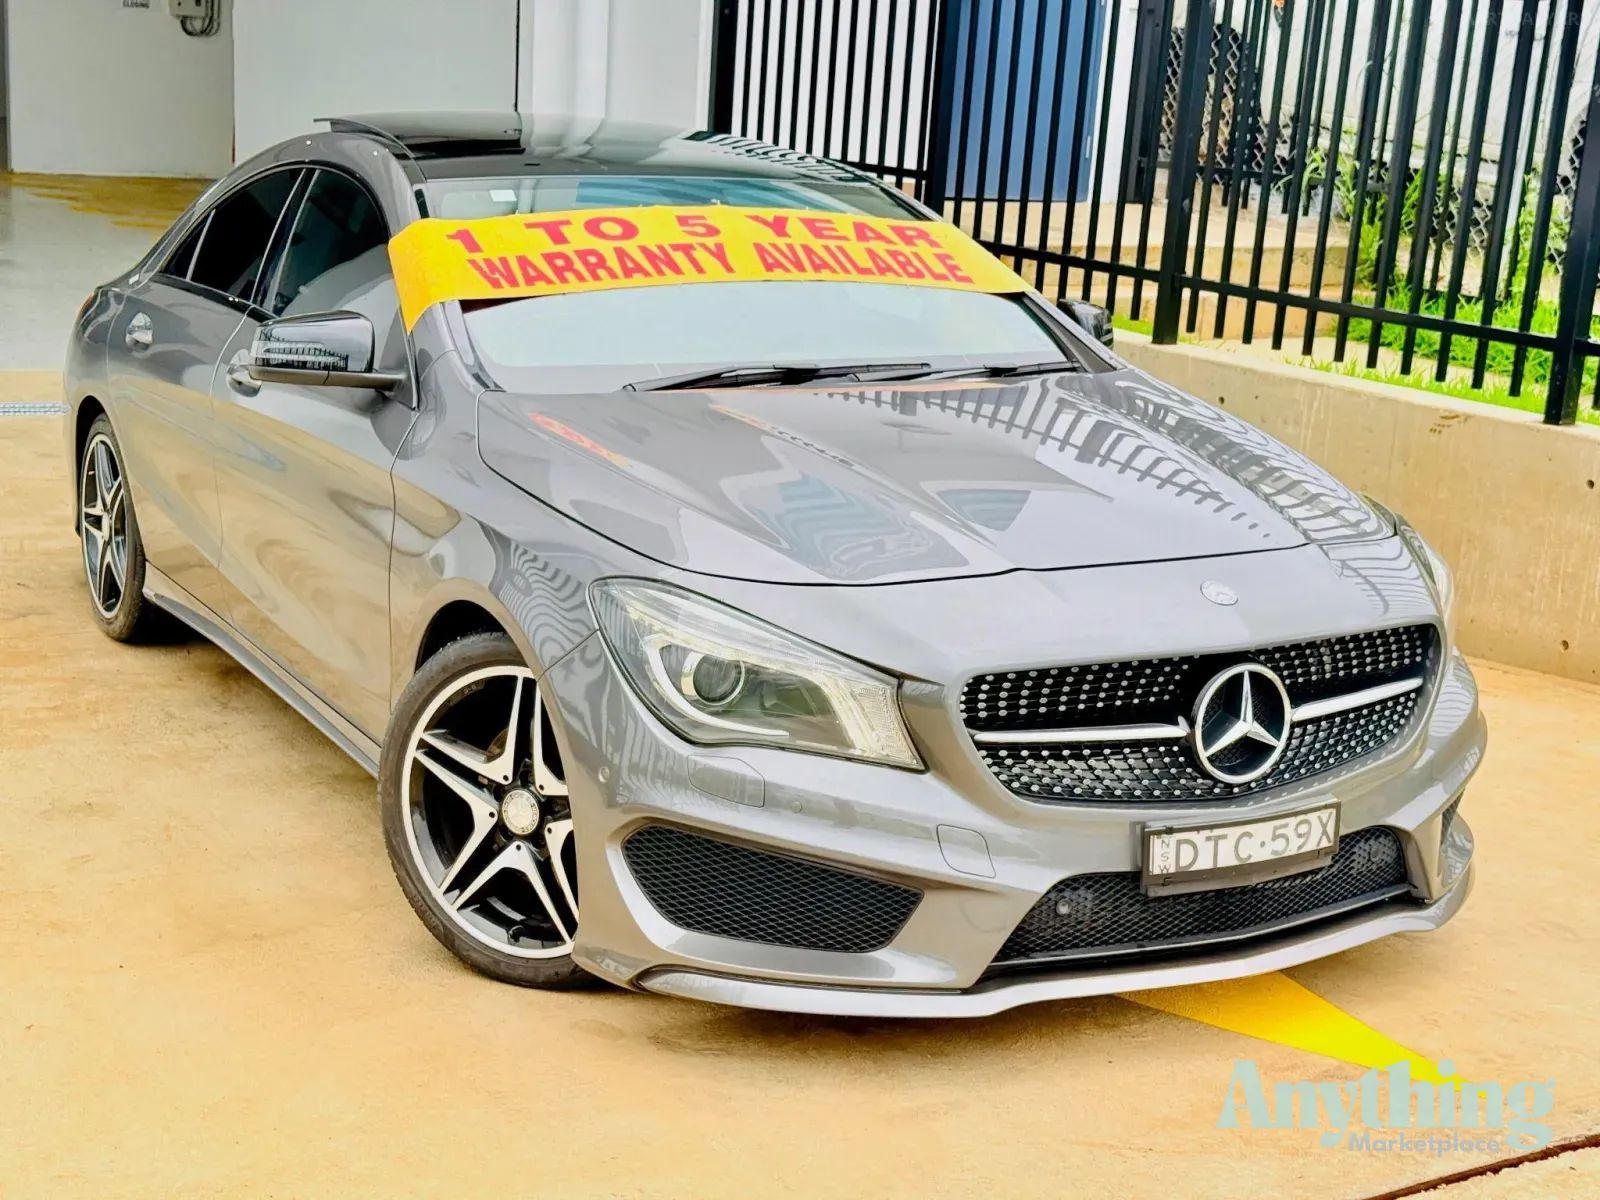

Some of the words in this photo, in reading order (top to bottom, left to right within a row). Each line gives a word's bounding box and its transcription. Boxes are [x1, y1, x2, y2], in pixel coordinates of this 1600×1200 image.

[446, 229, 483, 253] 1
[523, 216, 640, 246] TO
[675, 215, 721, 238] 5
[744, 215, 943, 249] YEAR
[467, 242, 736, 289] WARRANTY
[752, 242, 975, 284] AVAILABLE
